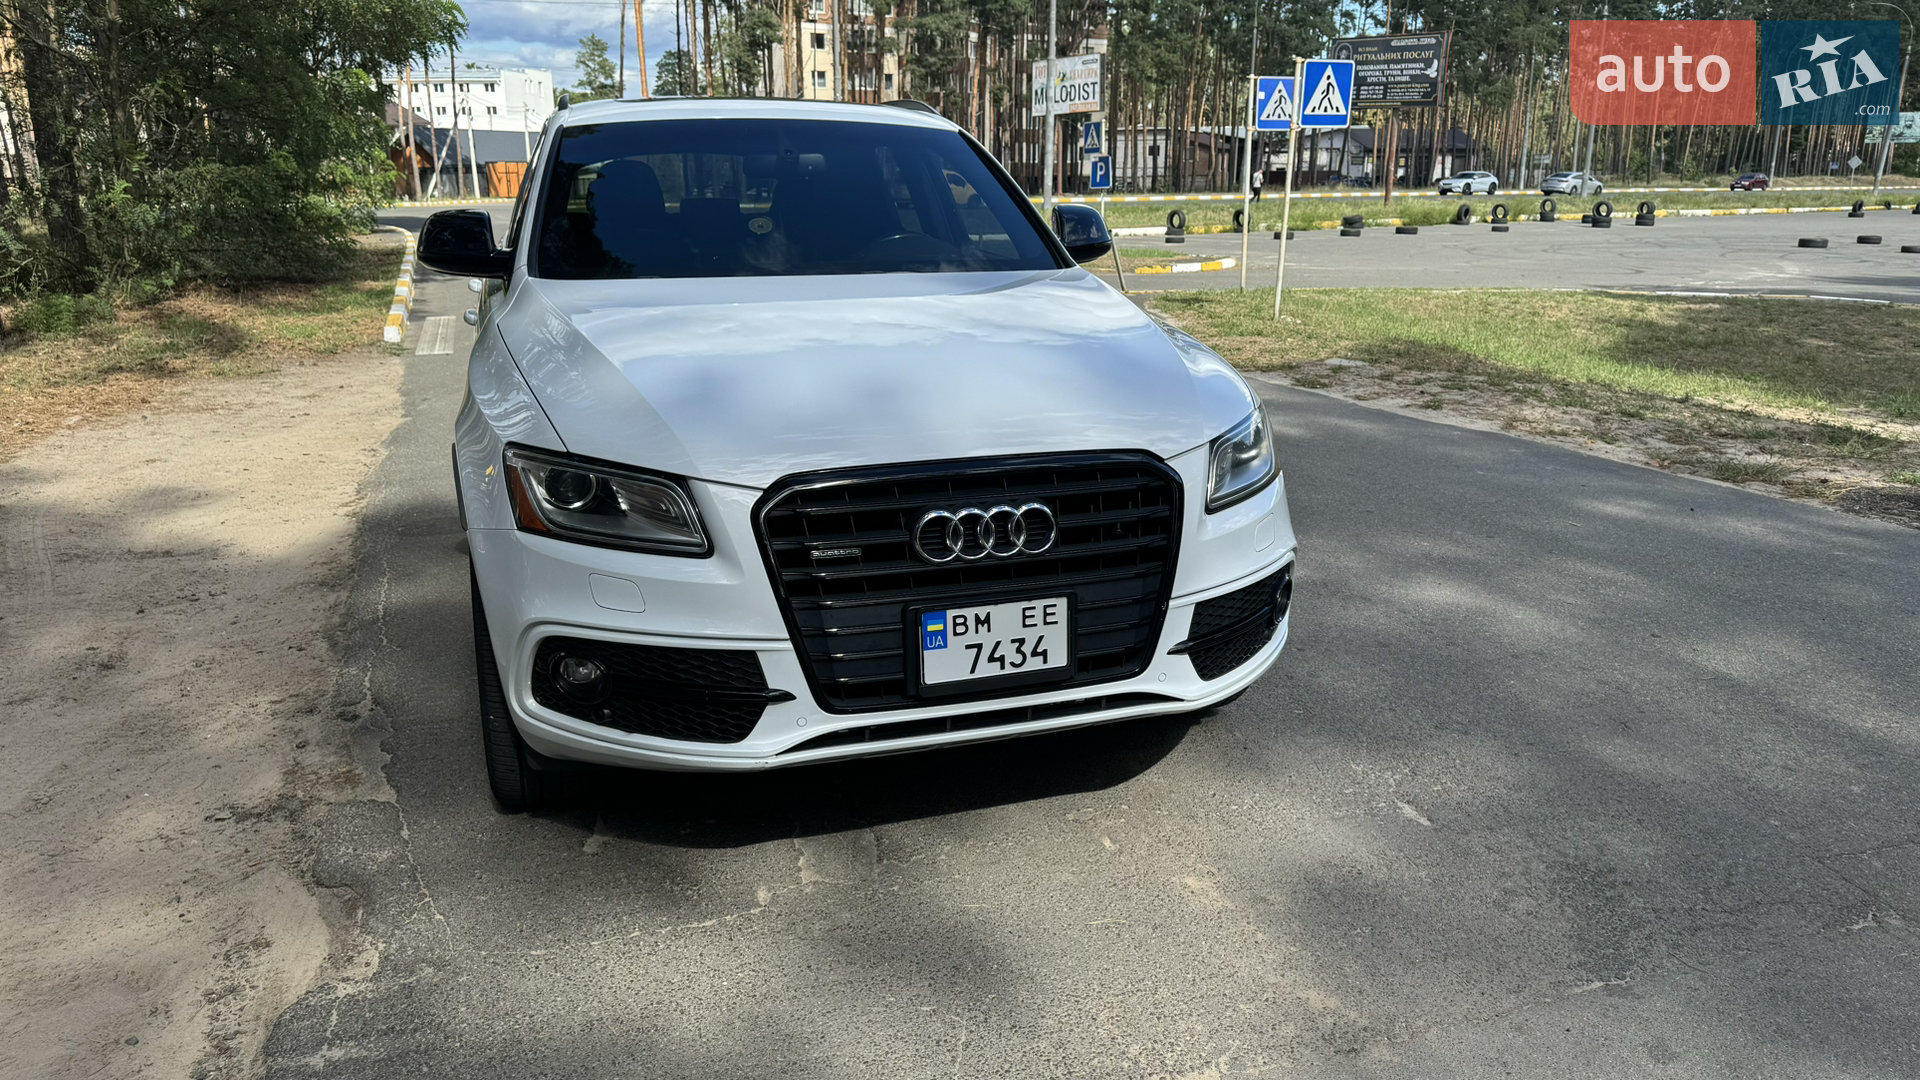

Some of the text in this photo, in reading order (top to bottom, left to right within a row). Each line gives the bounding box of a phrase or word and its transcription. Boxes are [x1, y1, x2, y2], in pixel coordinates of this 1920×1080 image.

[1353, 50, 1435, 61] РИТУАЛЬНИХ ПОСЛУГ
[1034, 81, 1098, 106] MLODIST
[1096, 162, 1106, 183] P
[952, 603, 1059, 637] BM EE
[926, 634, 1048, 675] UA 7434
